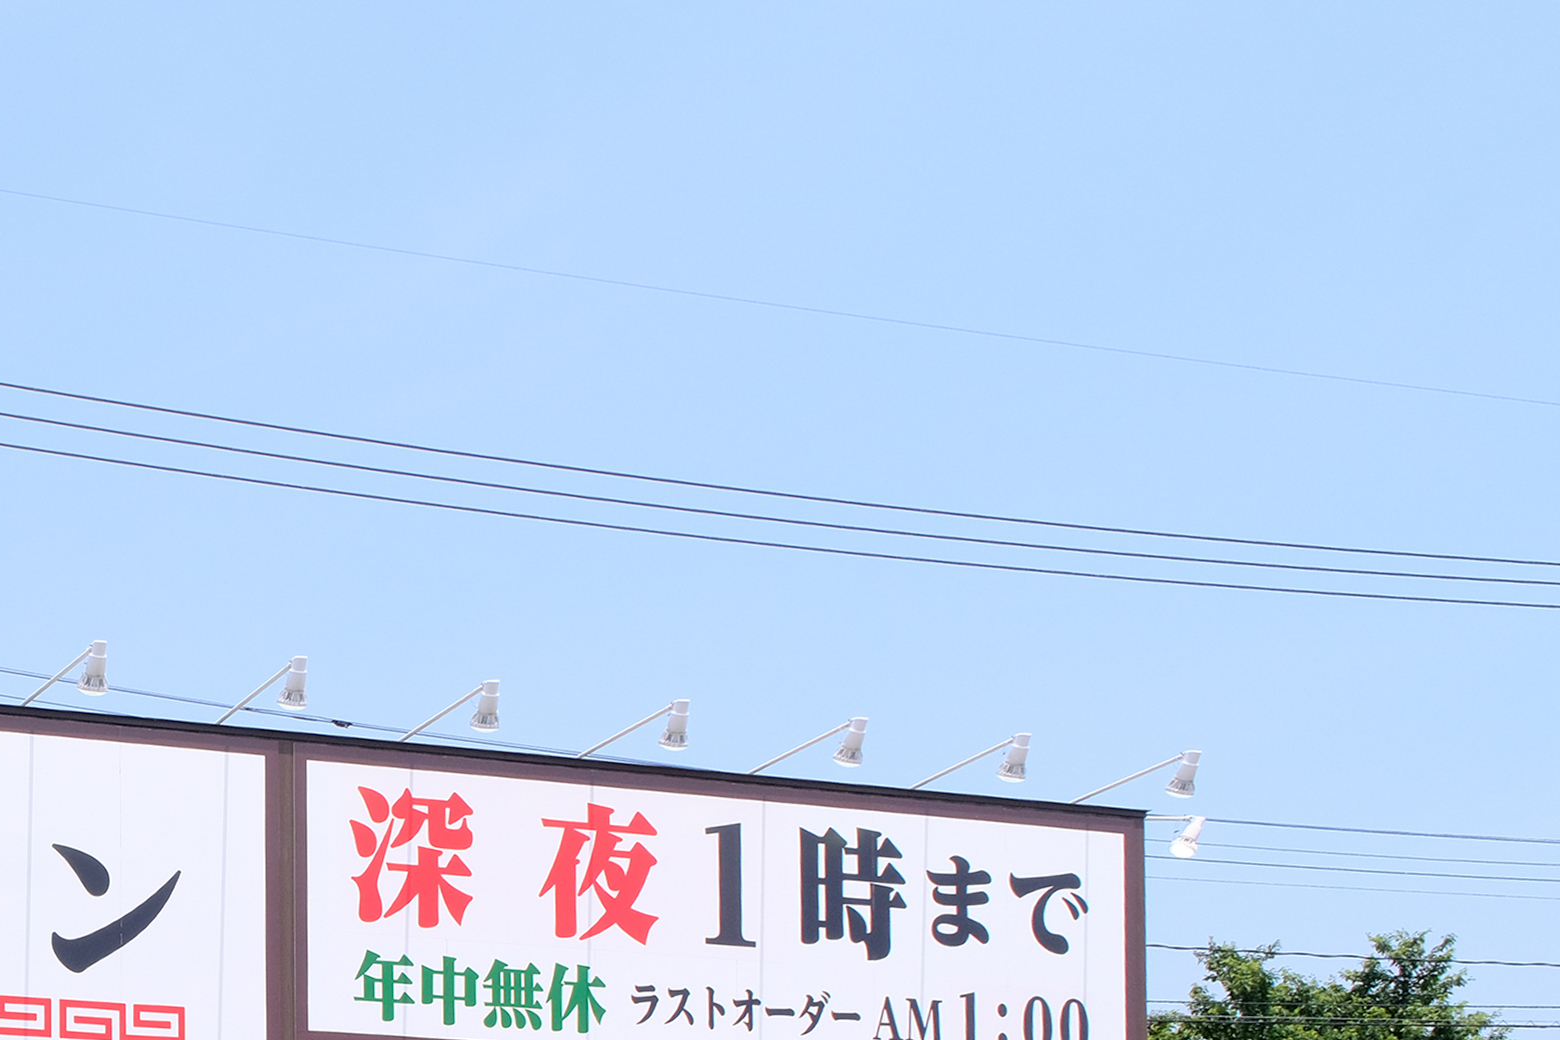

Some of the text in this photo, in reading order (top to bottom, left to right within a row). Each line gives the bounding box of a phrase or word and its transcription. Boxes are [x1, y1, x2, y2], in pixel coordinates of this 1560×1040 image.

[354, 949, 607, 1034] 年中無休
[631, 985, 861, 1036] ラストオーダー
